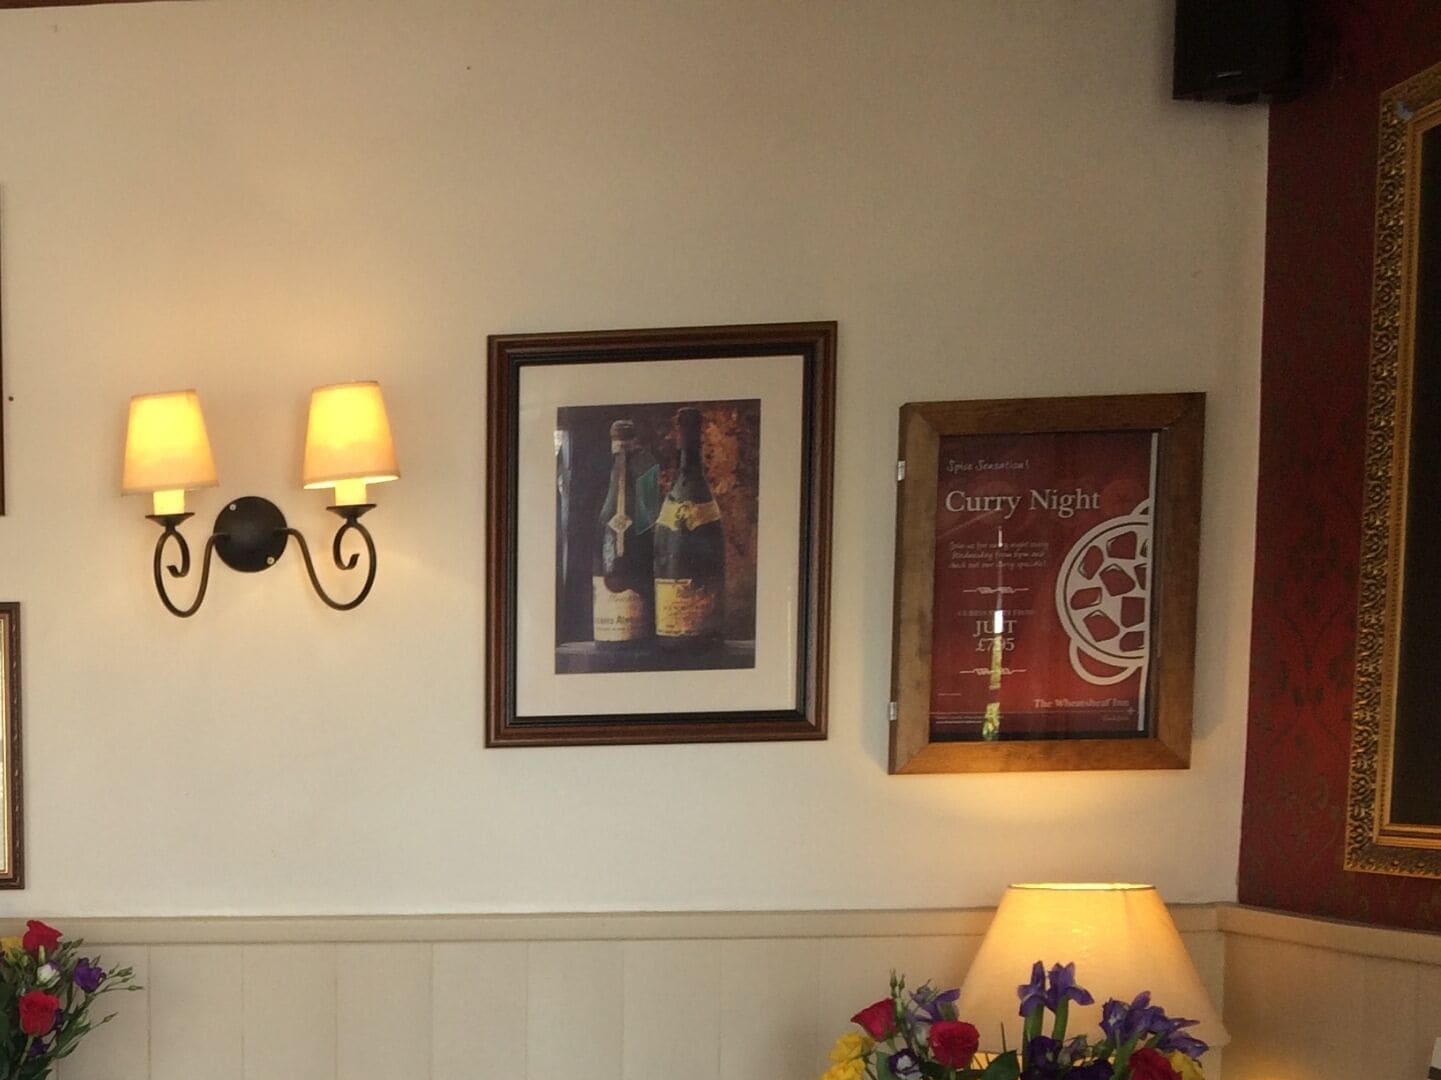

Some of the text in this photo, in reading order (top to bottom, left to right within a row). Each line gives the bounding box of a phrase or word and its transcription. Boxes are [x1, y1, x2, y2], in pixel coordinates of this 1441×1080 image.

[944, 487, 1102, 520] Curry Night
[972, 619, 1018, 637] JUT
[975, 637, 1016, 652] £75
